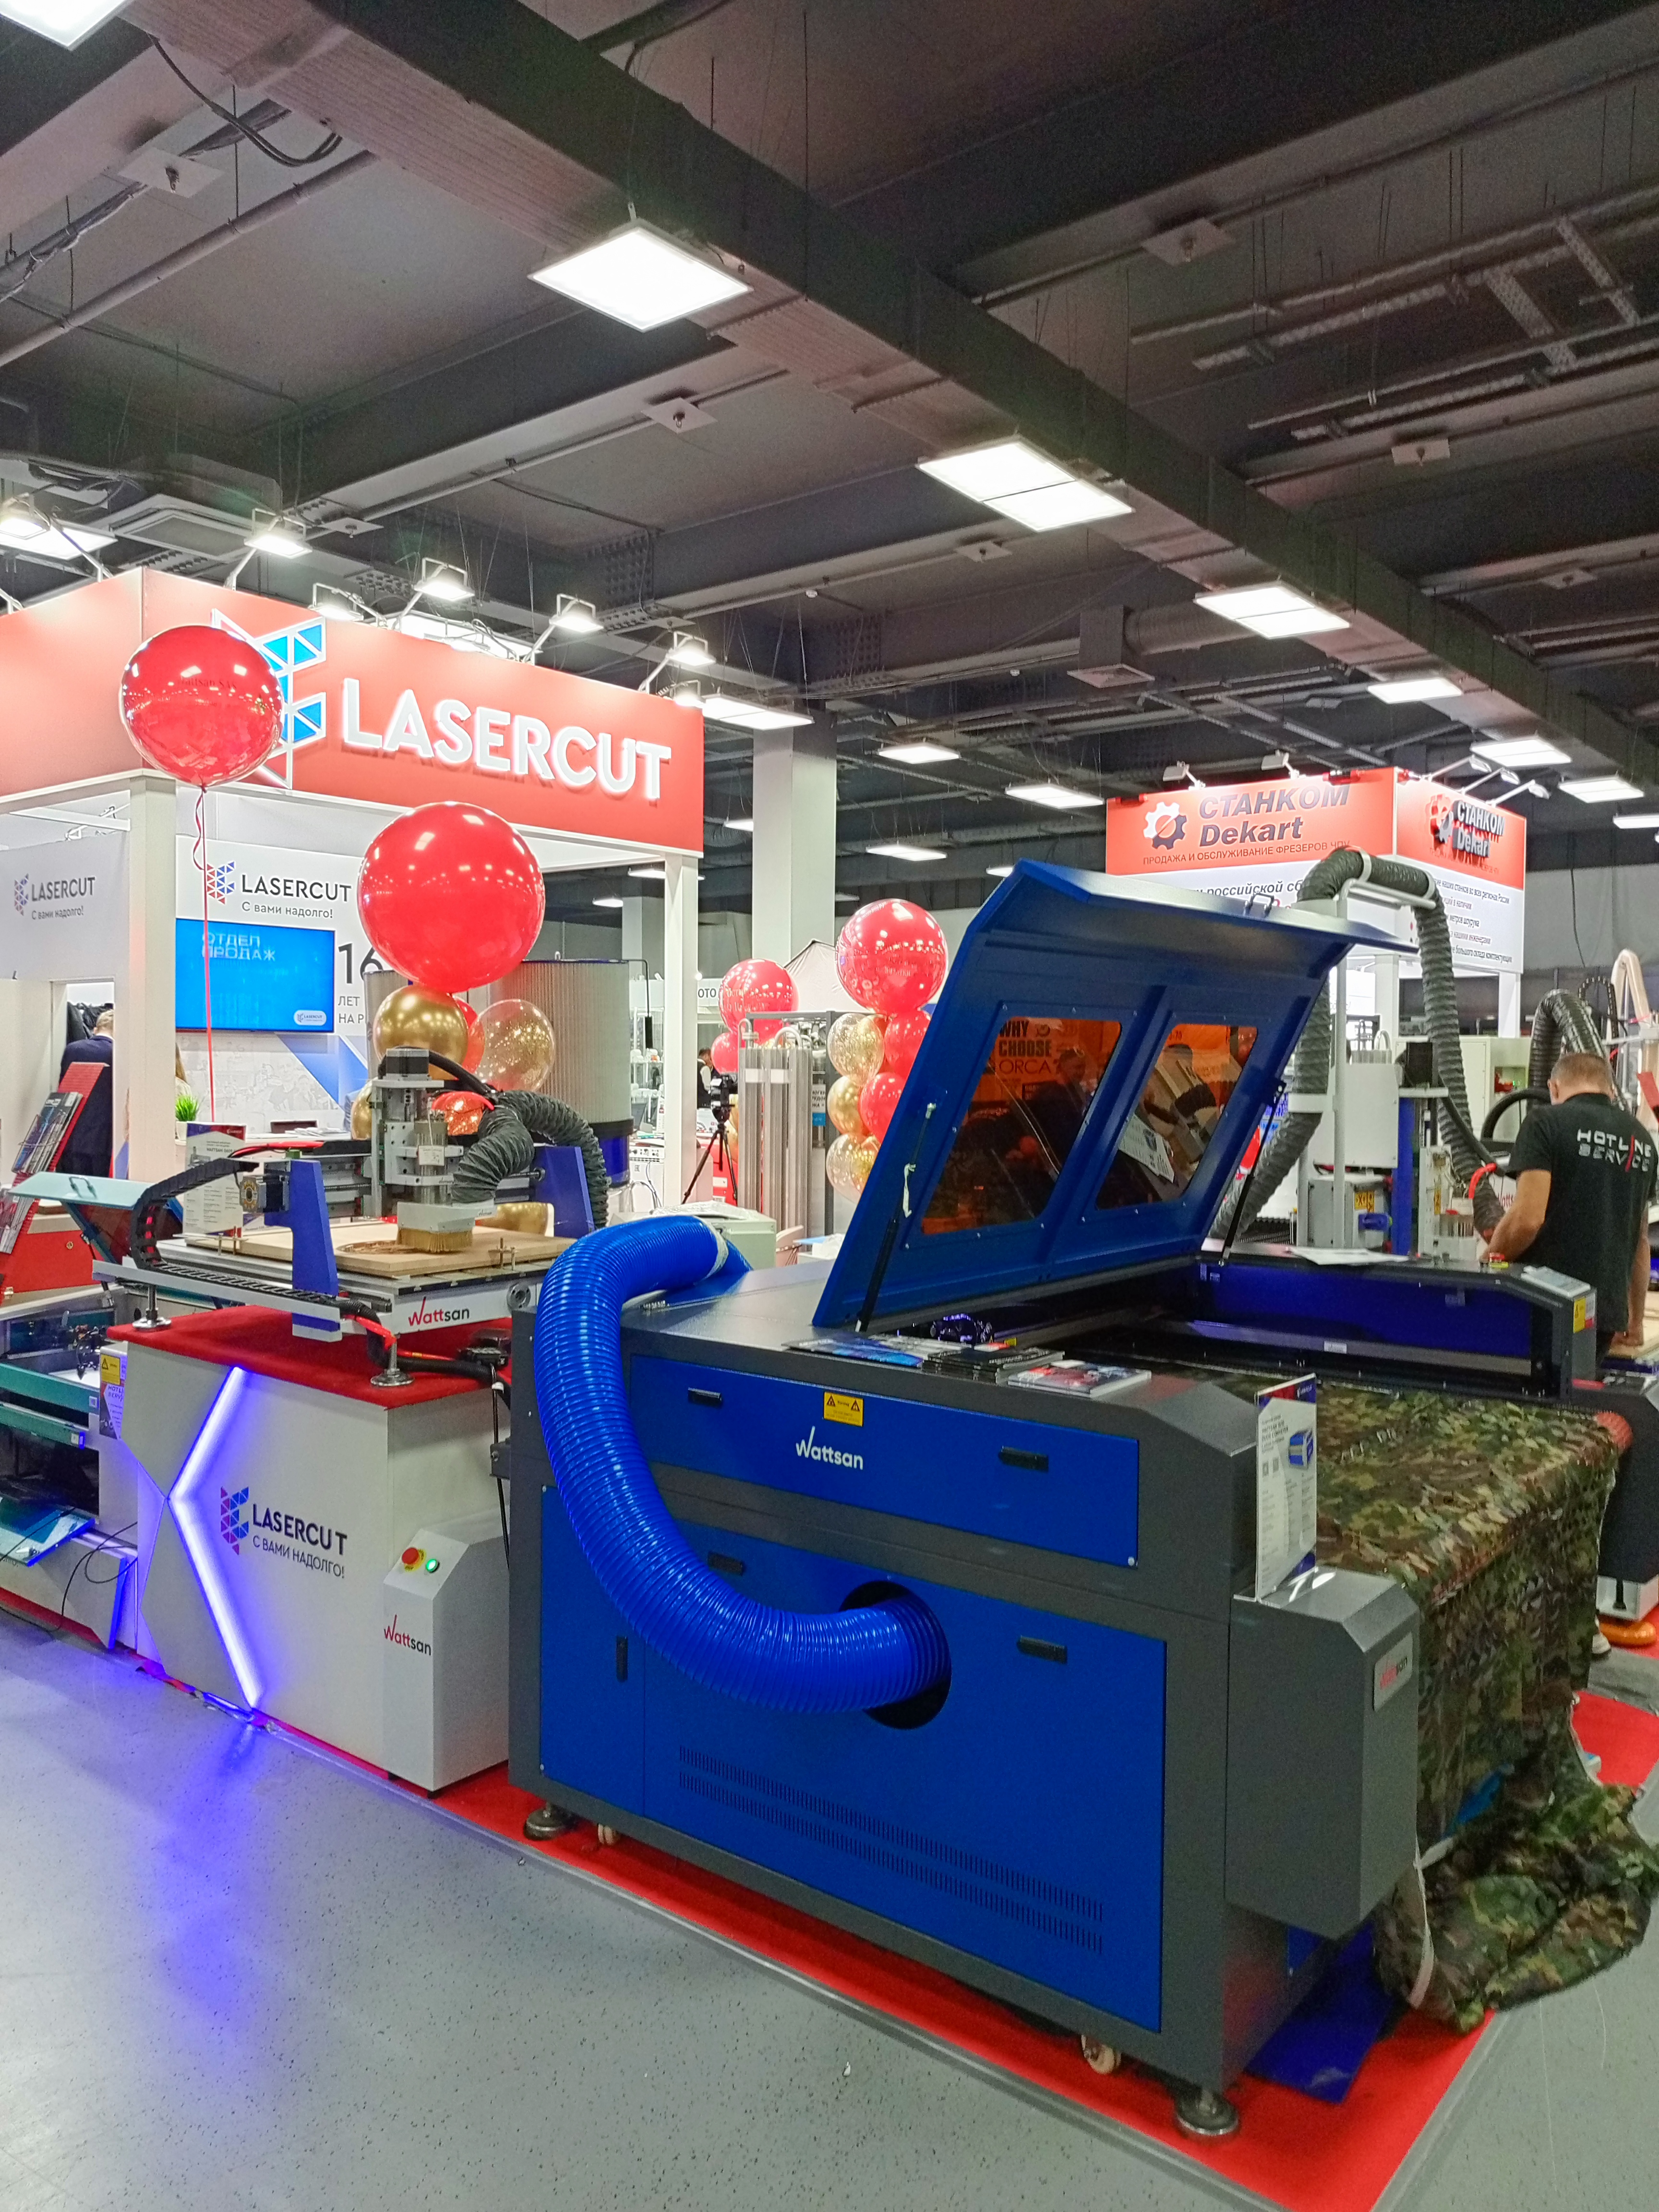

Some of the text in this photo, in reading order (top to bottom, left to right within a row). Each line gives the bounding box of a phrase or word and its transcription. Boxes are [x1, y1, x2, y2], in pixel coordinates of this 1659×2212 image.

[344, 678, 672, 799] LASERCUT
[1200, 784, 1350, 819] СТАНКОМ
[1199, 817, 1304, 847] Dekart
[1455, 800, 1505, 837] СТАНКОМ
[1143, 854, 1186, 865] ПРОДАЖА
[1189, 853, 1195, 861] И
[1197, 847, 1274, 861] ОБСЛУЖИВАНИЕ
[1276, 842, 1328, 854] ФРЕЗЕРОВ
[32, 877, 96, 902] LASERCUT
[242, 874, 352, 902] LASERCUT
[1207, 880, 1283, 896] российской
[32, 905, 84, 920] С вами надолго!
[242, 901, 333, 918] С вами надолго!
[338, 996, 361, 1007] ЛЕТ
[338, 1013, 355, 1024] НА
[1000, 1020, 1030, 1037] WHY
[998, 1040, 1052, 1058] CHOOSE
[408, 1296, 470, 1327] Wattsan
[795, 1425, 863, 1470] Wattsan
[252, 1503, 348, 1556] LASERCUT
[252, 1535, 345, 1579] С ВАМИ НАДОЛГО!
[384, 1614, 432, 1656] Wattsan
